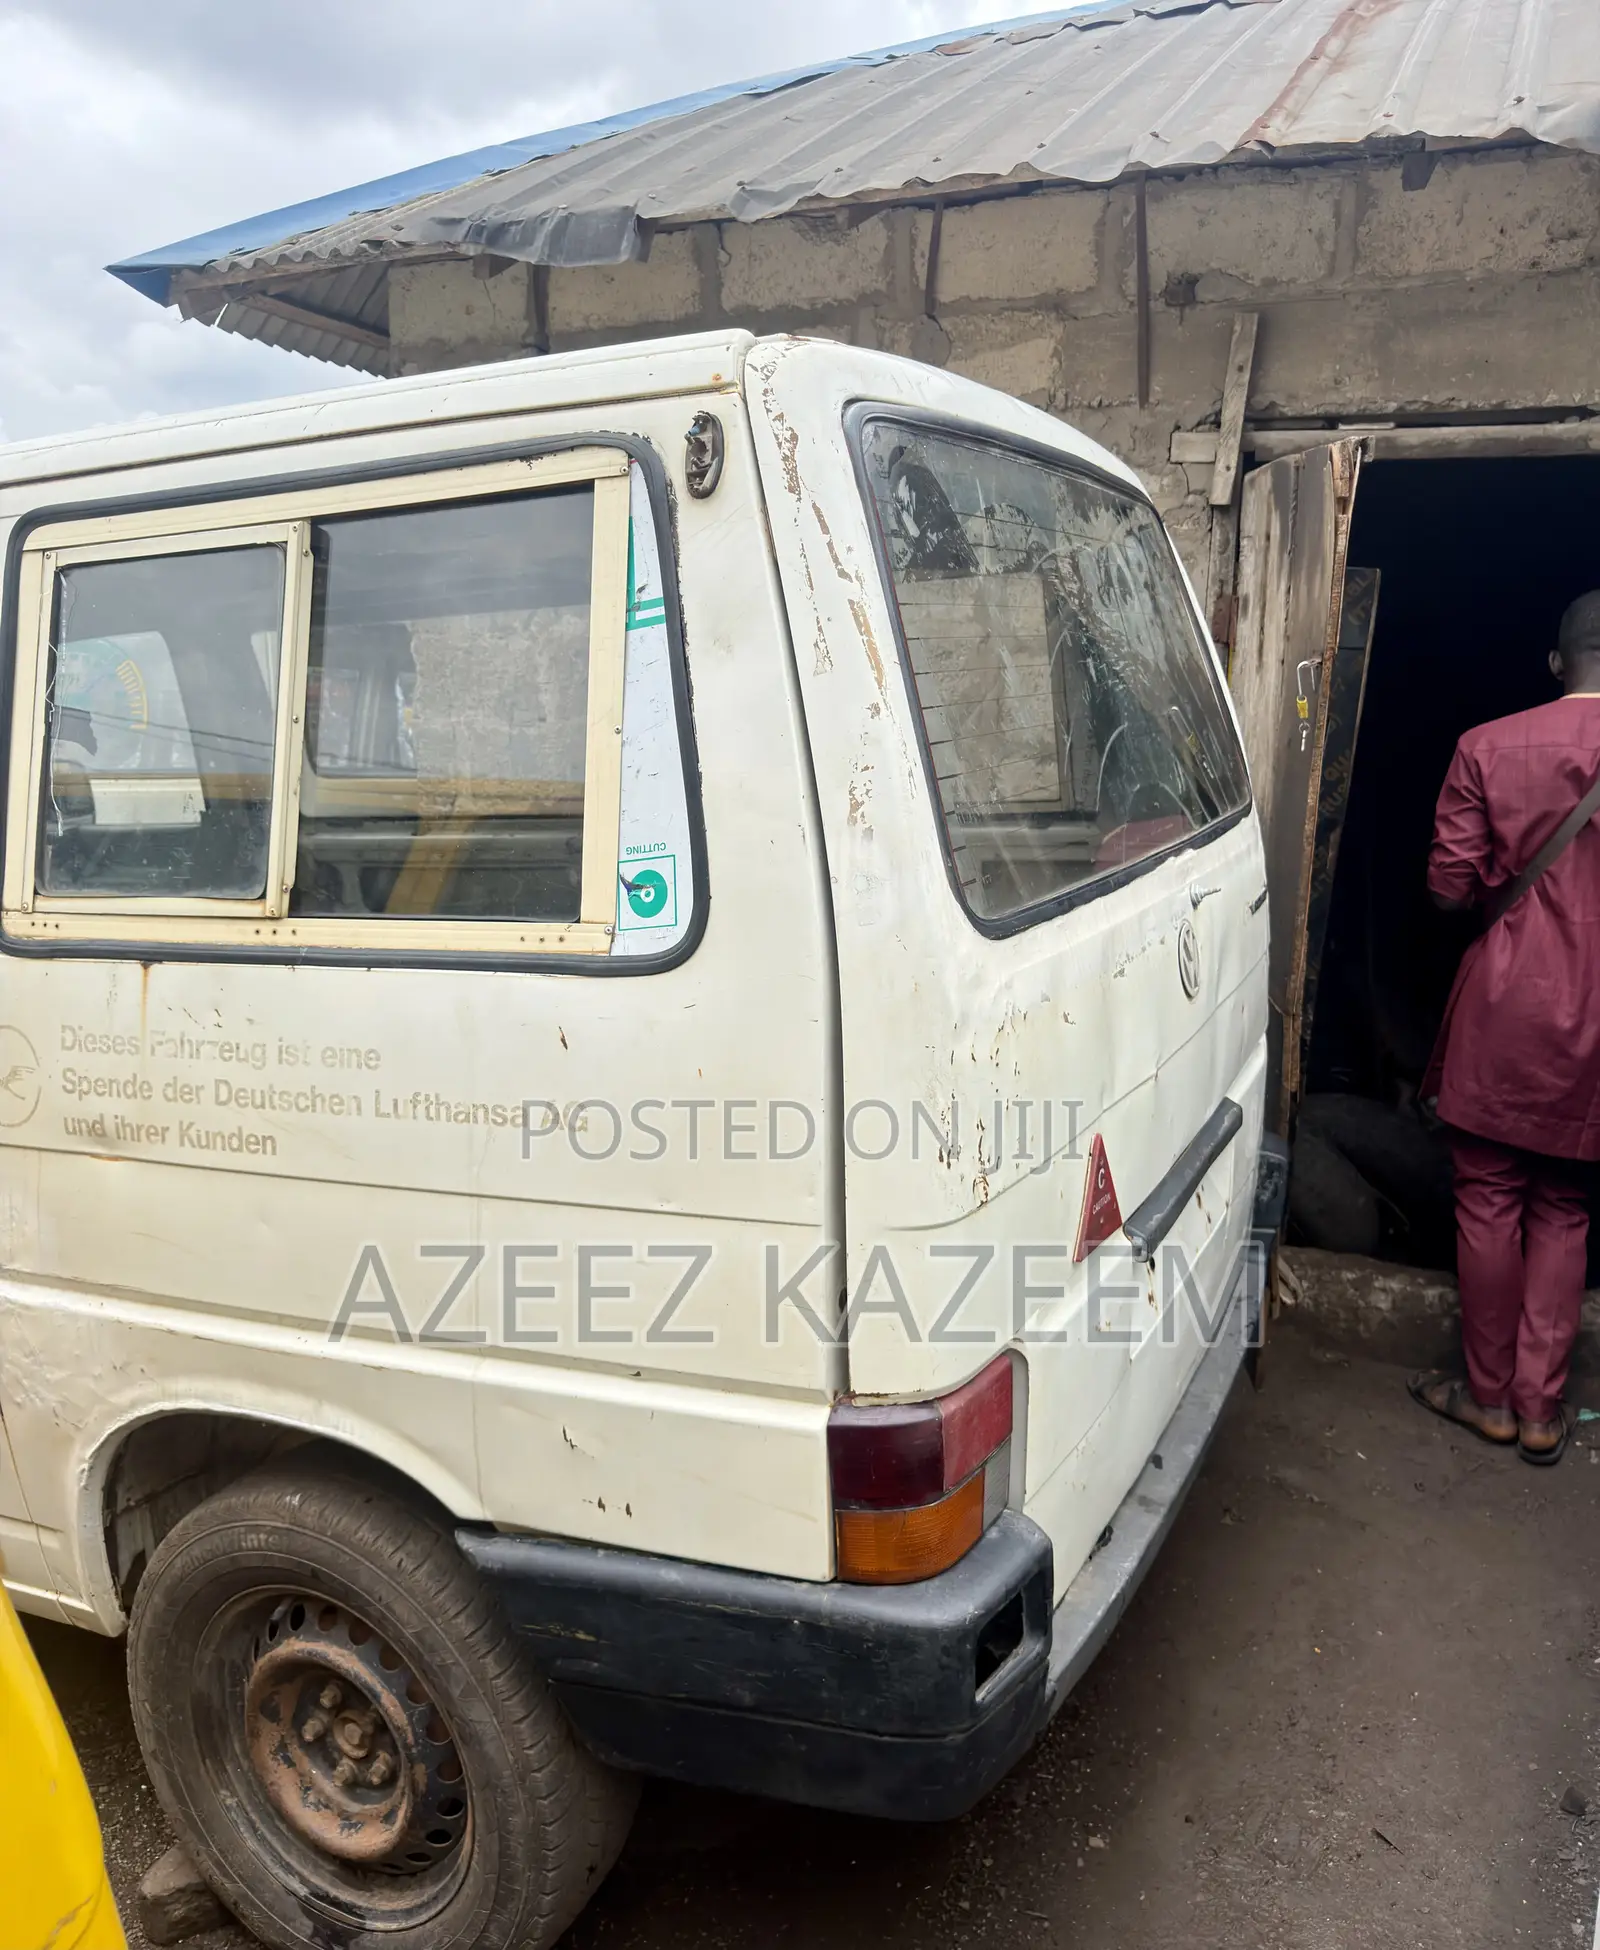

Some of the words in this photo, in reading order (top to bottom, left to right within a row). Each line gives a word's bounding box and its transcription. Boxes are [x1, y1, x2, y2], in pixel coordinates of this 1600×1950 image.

[625, 842, 667, 855] CUTTING
[60, 1024, 140, 1056] Dieses
[150, 1030, 267, 1070] Fahrzeug
[277, 1037, 311, 1066] ist
[320, 1046, 382, 1071] eine
[61, 1067, 153, 1101] Spende
[162, 1076, 205, 1106] der
[214, 1078, 363, 1117] Deutschen
[374, 1089, 529, 1128] Lufthansa
[63, 1113, 106, 1138] und
[114, 1114, 170, 1145] ihrer
[178, 1119, 278, 1156] Kunden
